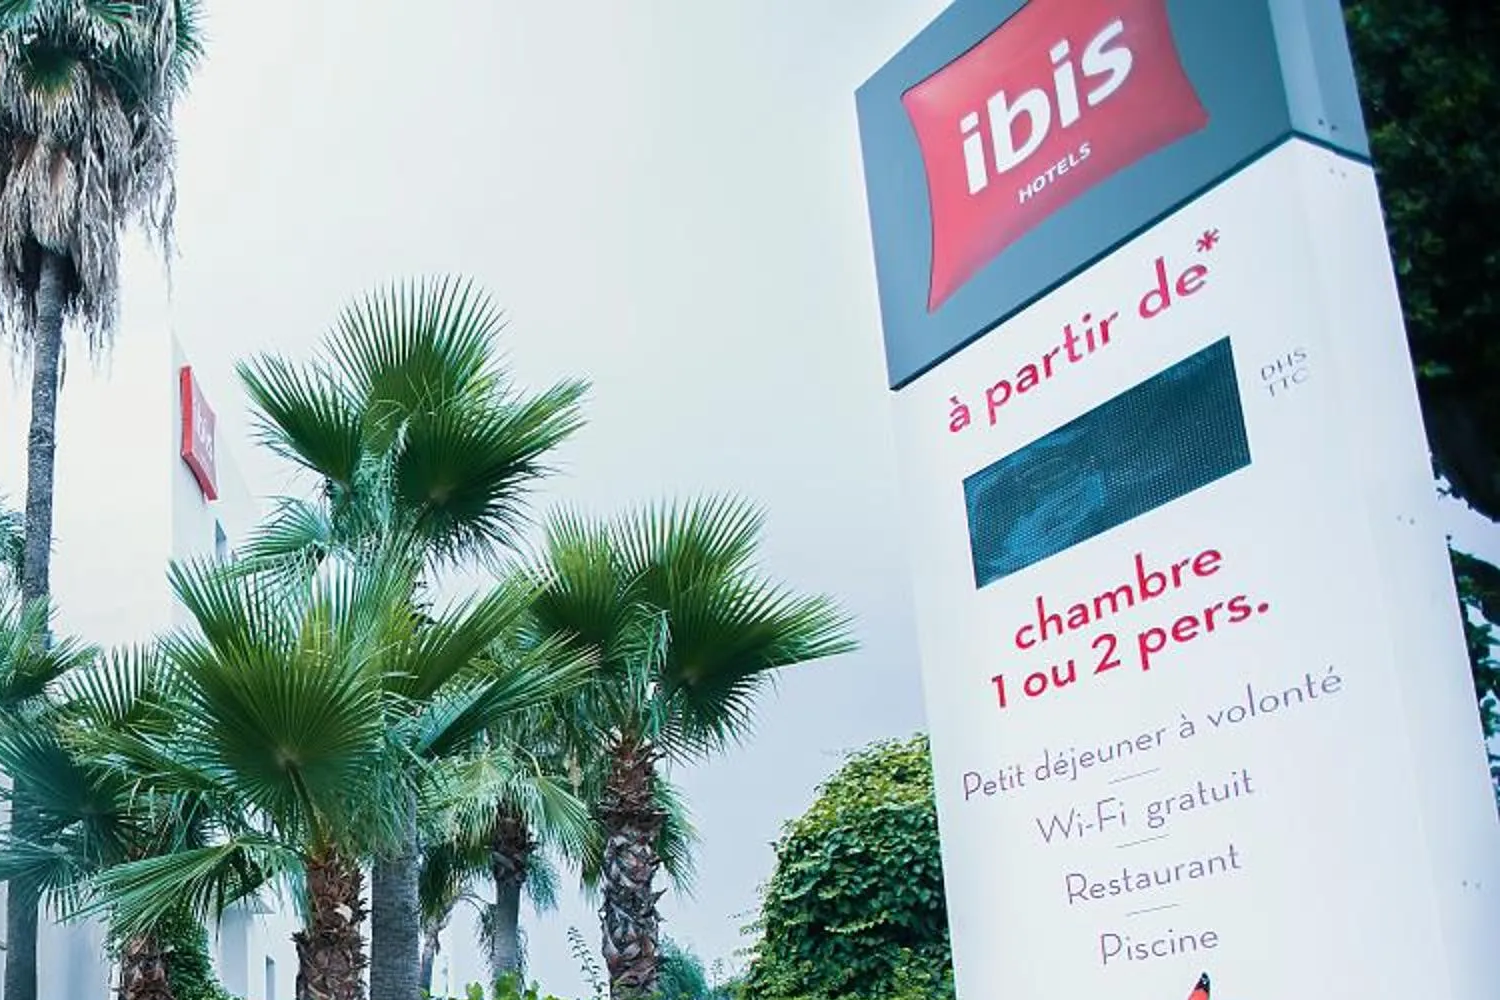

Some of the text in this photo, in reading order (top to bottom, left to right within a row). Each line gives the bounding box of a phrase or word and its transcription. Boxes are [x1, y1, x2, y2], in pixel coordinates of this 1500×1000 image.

[959, 17, 1134, 195] ibis
[1018, 143, 1092, 203] HOTELS
[948, 396, 971, 433] à
[986, 307, 1119, 425] partir
[1014, 548, 1223, 649] chambre
[991, 592, 1270, 709] 1 ou 2 pers.
[963, 666, 1344, 801] Petit déjeuner à volonté
[1036, 769, 1255, 844] Wi-Fi gratuit
[1066, 844, 1241, 905] Restaurant
[1100, 928, 1220, 965] Piscine
